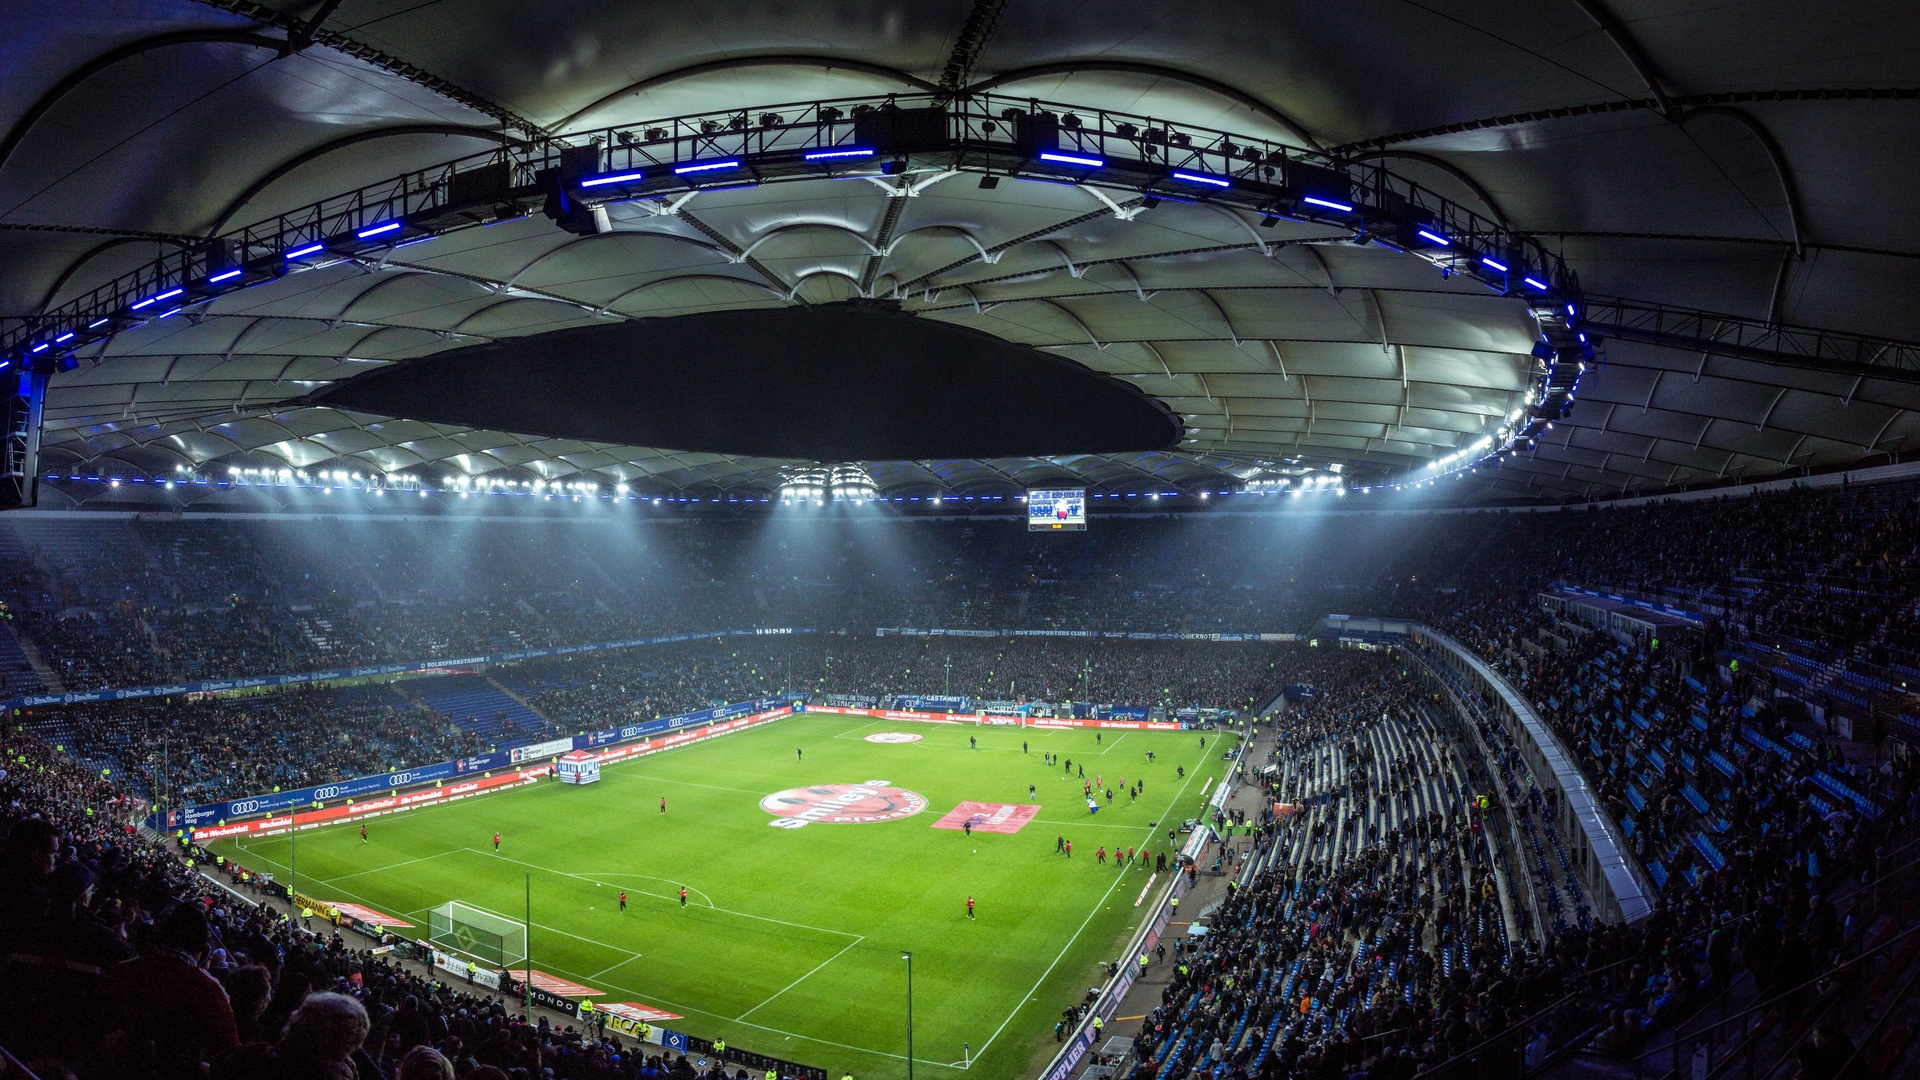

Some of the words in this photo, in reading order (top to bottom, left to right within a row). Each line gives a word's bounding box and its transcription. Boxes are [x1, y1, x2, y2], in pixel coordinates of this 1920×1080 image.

[426, 656, 484, 668] VOLKSPARKSTADION
[469, 758, 490, 766] Hamburger
[401, 796, 413, 804] Elbe
[413, 791, 443, 802] Wochenblatt
[768, 780, 892, 829] Smiley's
[185, 810, 215, 820] Hamburger
[833, 812, 904, 822] Pizza
[259, 817, 293, 829] Wochenblatt
[194, 831, 209, 840] Elbe
[209, 825, 249, 837] Wochenblatt
[592, 1009, 652, 1040] TARCAR
[1049, 1041, 1086, 1080] PPLIER
